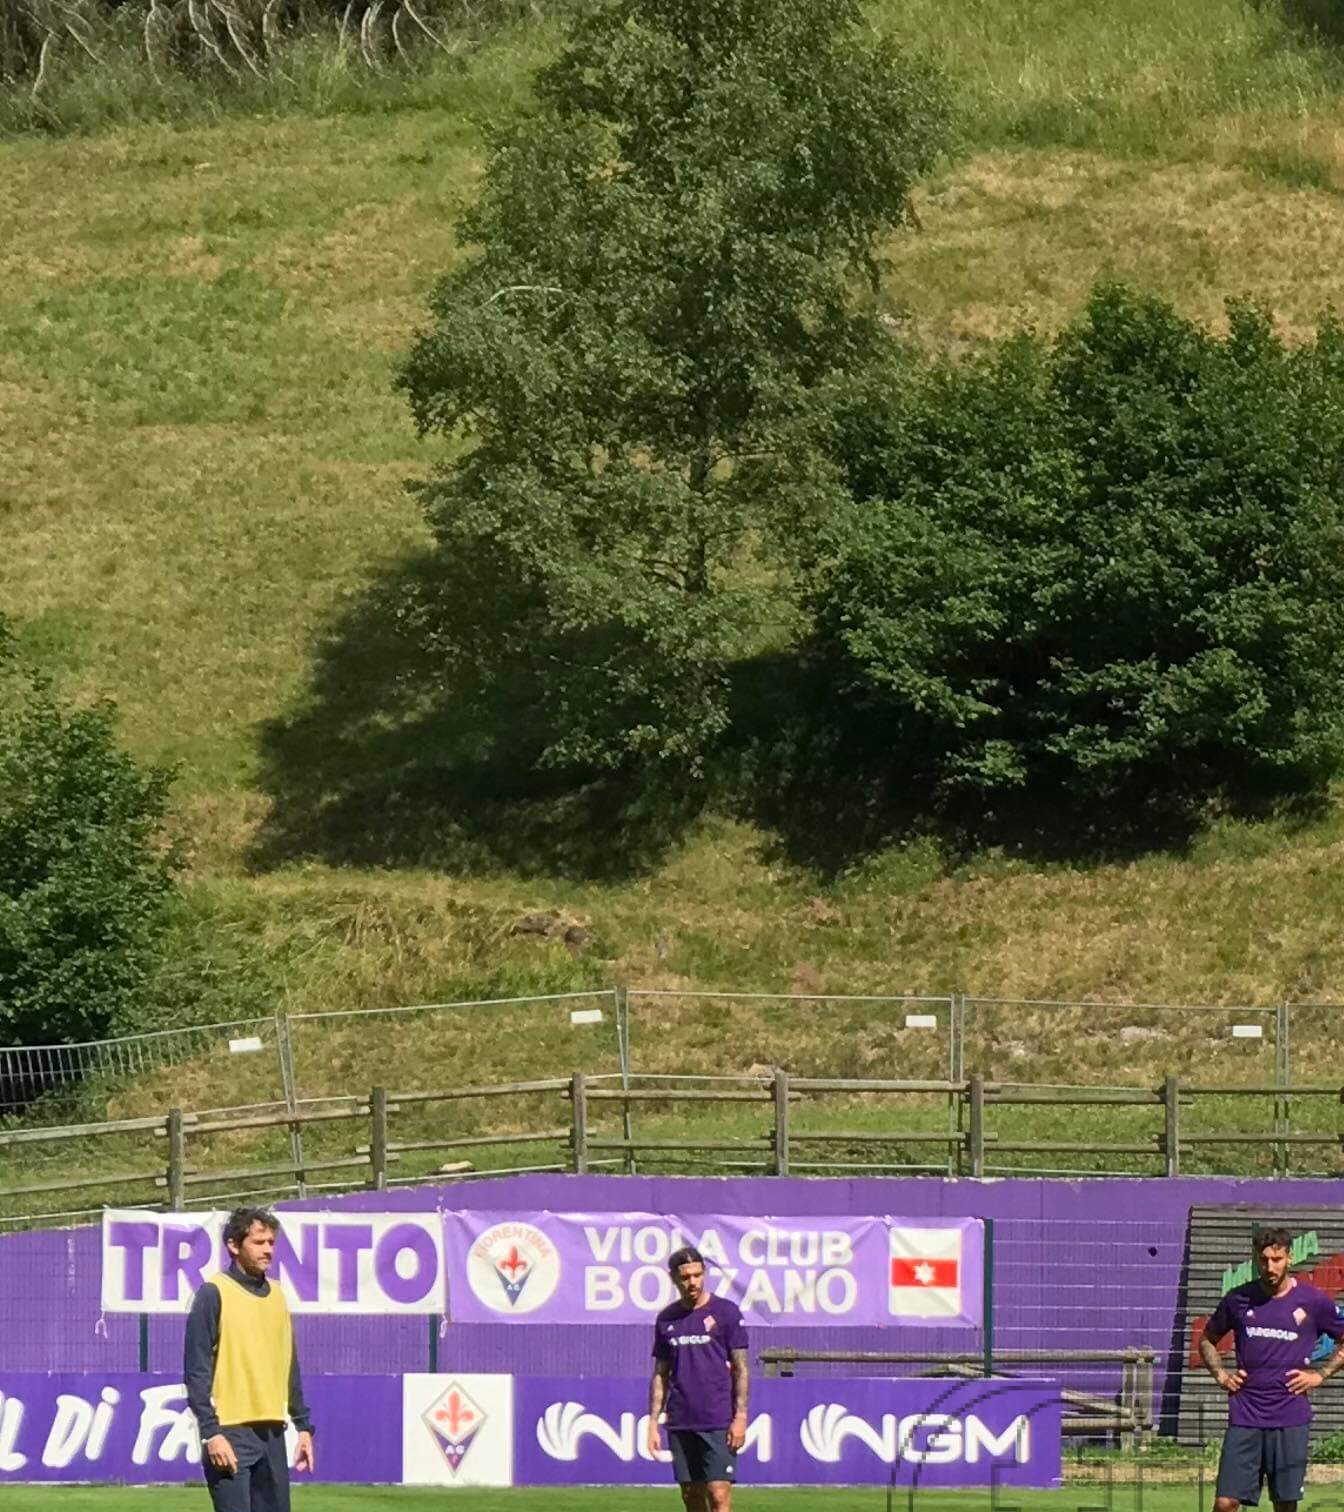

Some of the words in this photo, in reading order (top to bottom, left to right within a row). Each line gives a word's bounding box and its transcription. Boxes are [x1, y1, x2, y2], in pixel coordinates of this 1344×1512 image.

[109, 1221, 439, 1304] TRNTO
[739, 1231, 853, 1267] CLUB
[584, 1266, 858, 1314] BOZANO
[836, 1413, 1031, 1464] NGM
